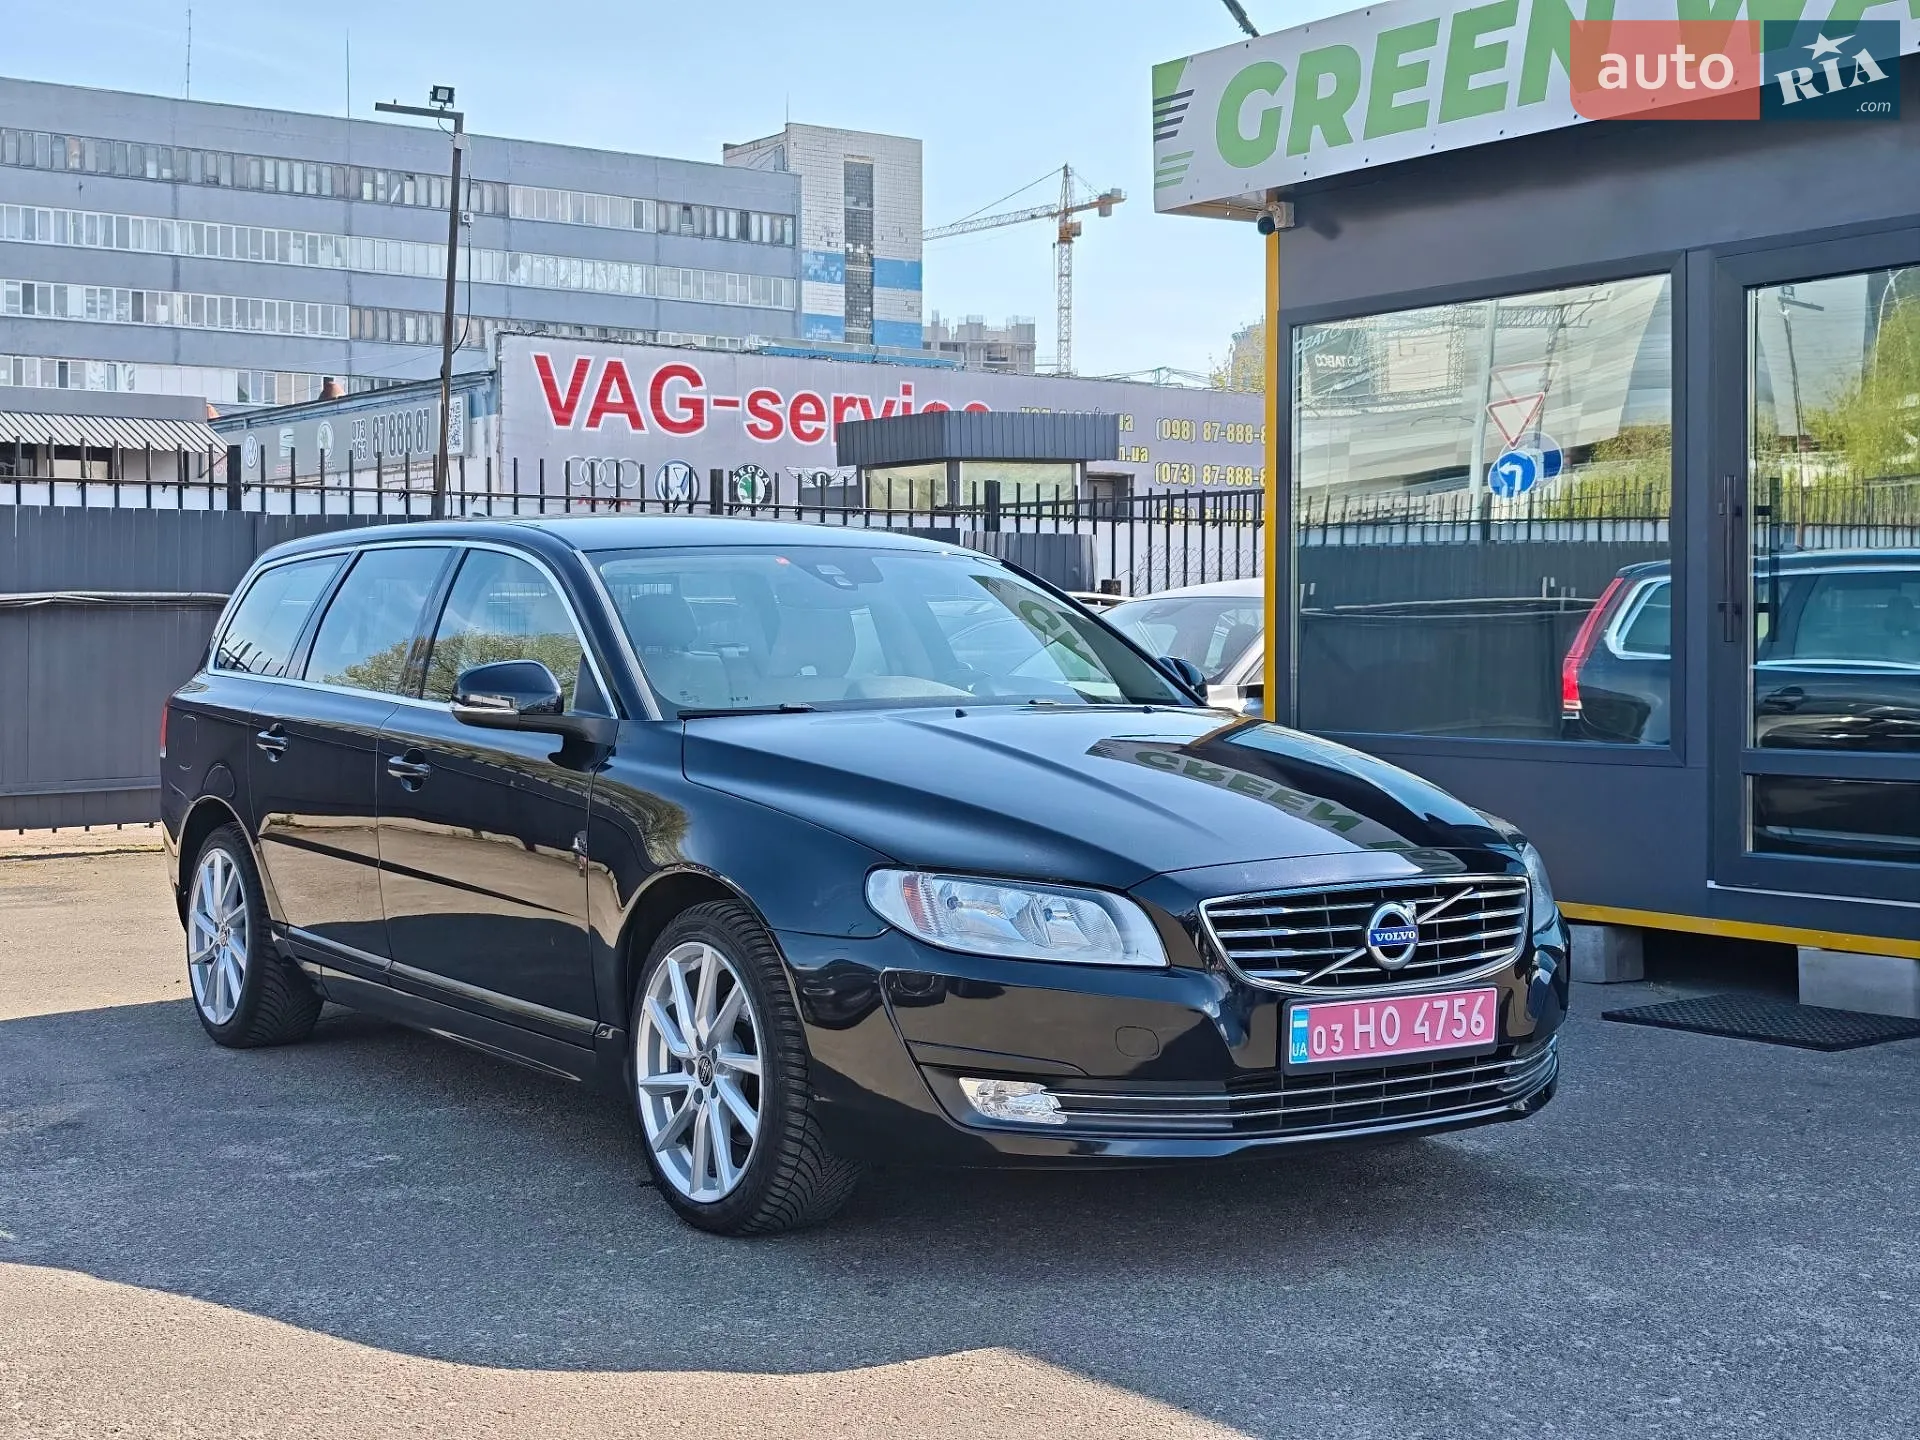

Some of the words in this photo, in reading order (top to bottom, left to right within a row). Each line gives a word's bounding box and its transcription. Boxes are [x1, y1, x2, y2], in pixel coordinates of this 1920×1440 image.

[1215, 0, 1616, 169] GREEN
[530, 351, 993, 446] VAG-ser
[372, 415, 386, 460] 87
[389, 410, 413, 458] 888
[416, 407, 430, 455] 87
[1156, 418, 1196, 443] (098)
[1155, 462, 1196, 487] (073)
[1373, 930, 1416, 942] VOLVO
[1312, 1024, 1344, 1055] 03
[1354, 1006, 1400, 1050] HO
[1413, 996, 1485, 1042] 4756
[1292, 1042, 1308, 1057] UA
